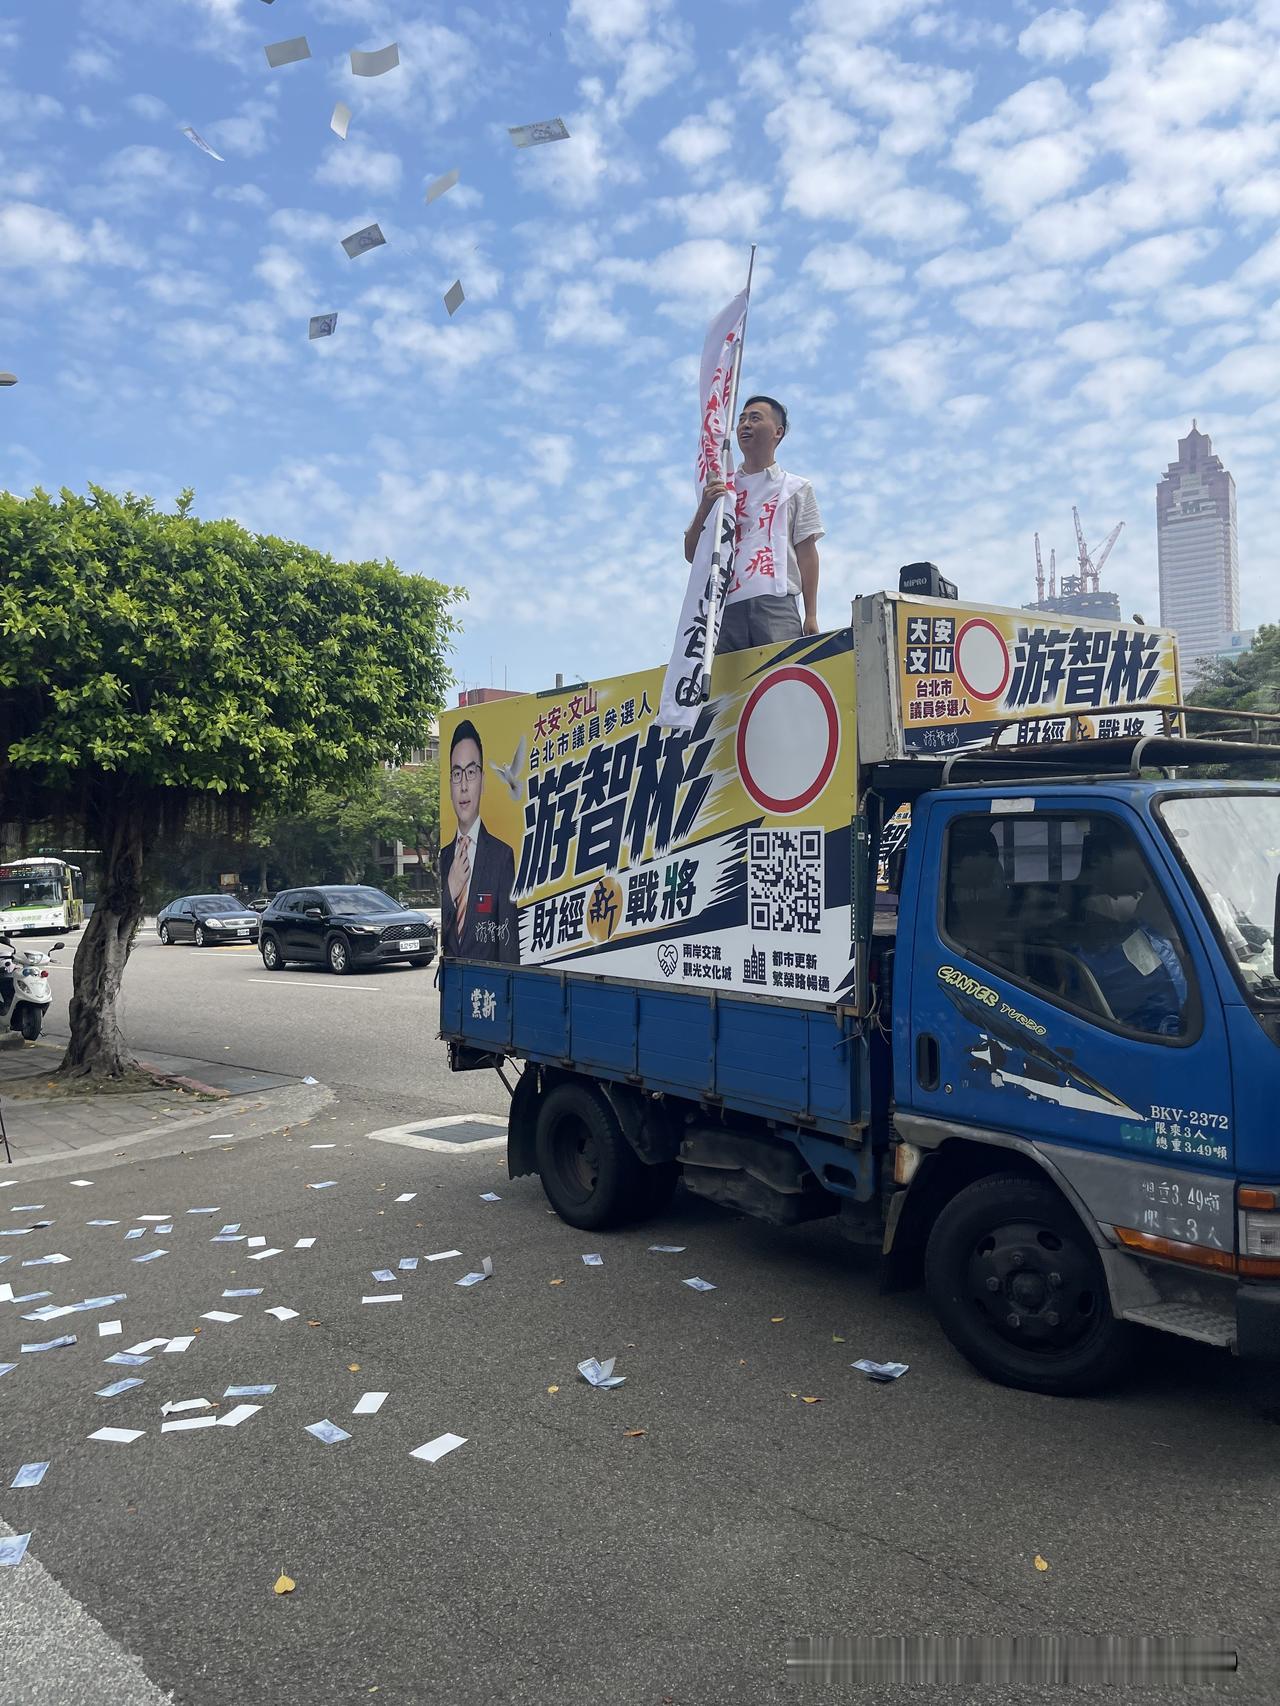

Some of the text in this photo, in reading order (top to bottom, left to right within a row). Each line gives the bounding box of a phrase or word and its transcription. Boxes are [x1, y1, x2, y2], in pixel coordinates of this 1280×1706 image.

[910, 619, 952, 643] 大安
[909, 648, 951, 673] 文山
[1003, 627, 1160, 708] 游智彬
[916, 679, 953, 698] 台北市
[909, 699, 971, 720] 議員參選人
[529, 691, 653, 771] 台北市議員參選人
[512, 704, 716, 899] 游智彬
[530, 858, 700, 952] 財經新戰將
[682, 943, 722, 962] 兩岸交流
[772, 950, 818, 971] 都市更新
[682, 961, 733, 982] 觀光文化城
[772, 970, 831, 994] 繁榮路暢通
[937, 965, 1047, 1036] CANTER TURBO
[1150, 1104, 1229, 1131] BKV-2372
